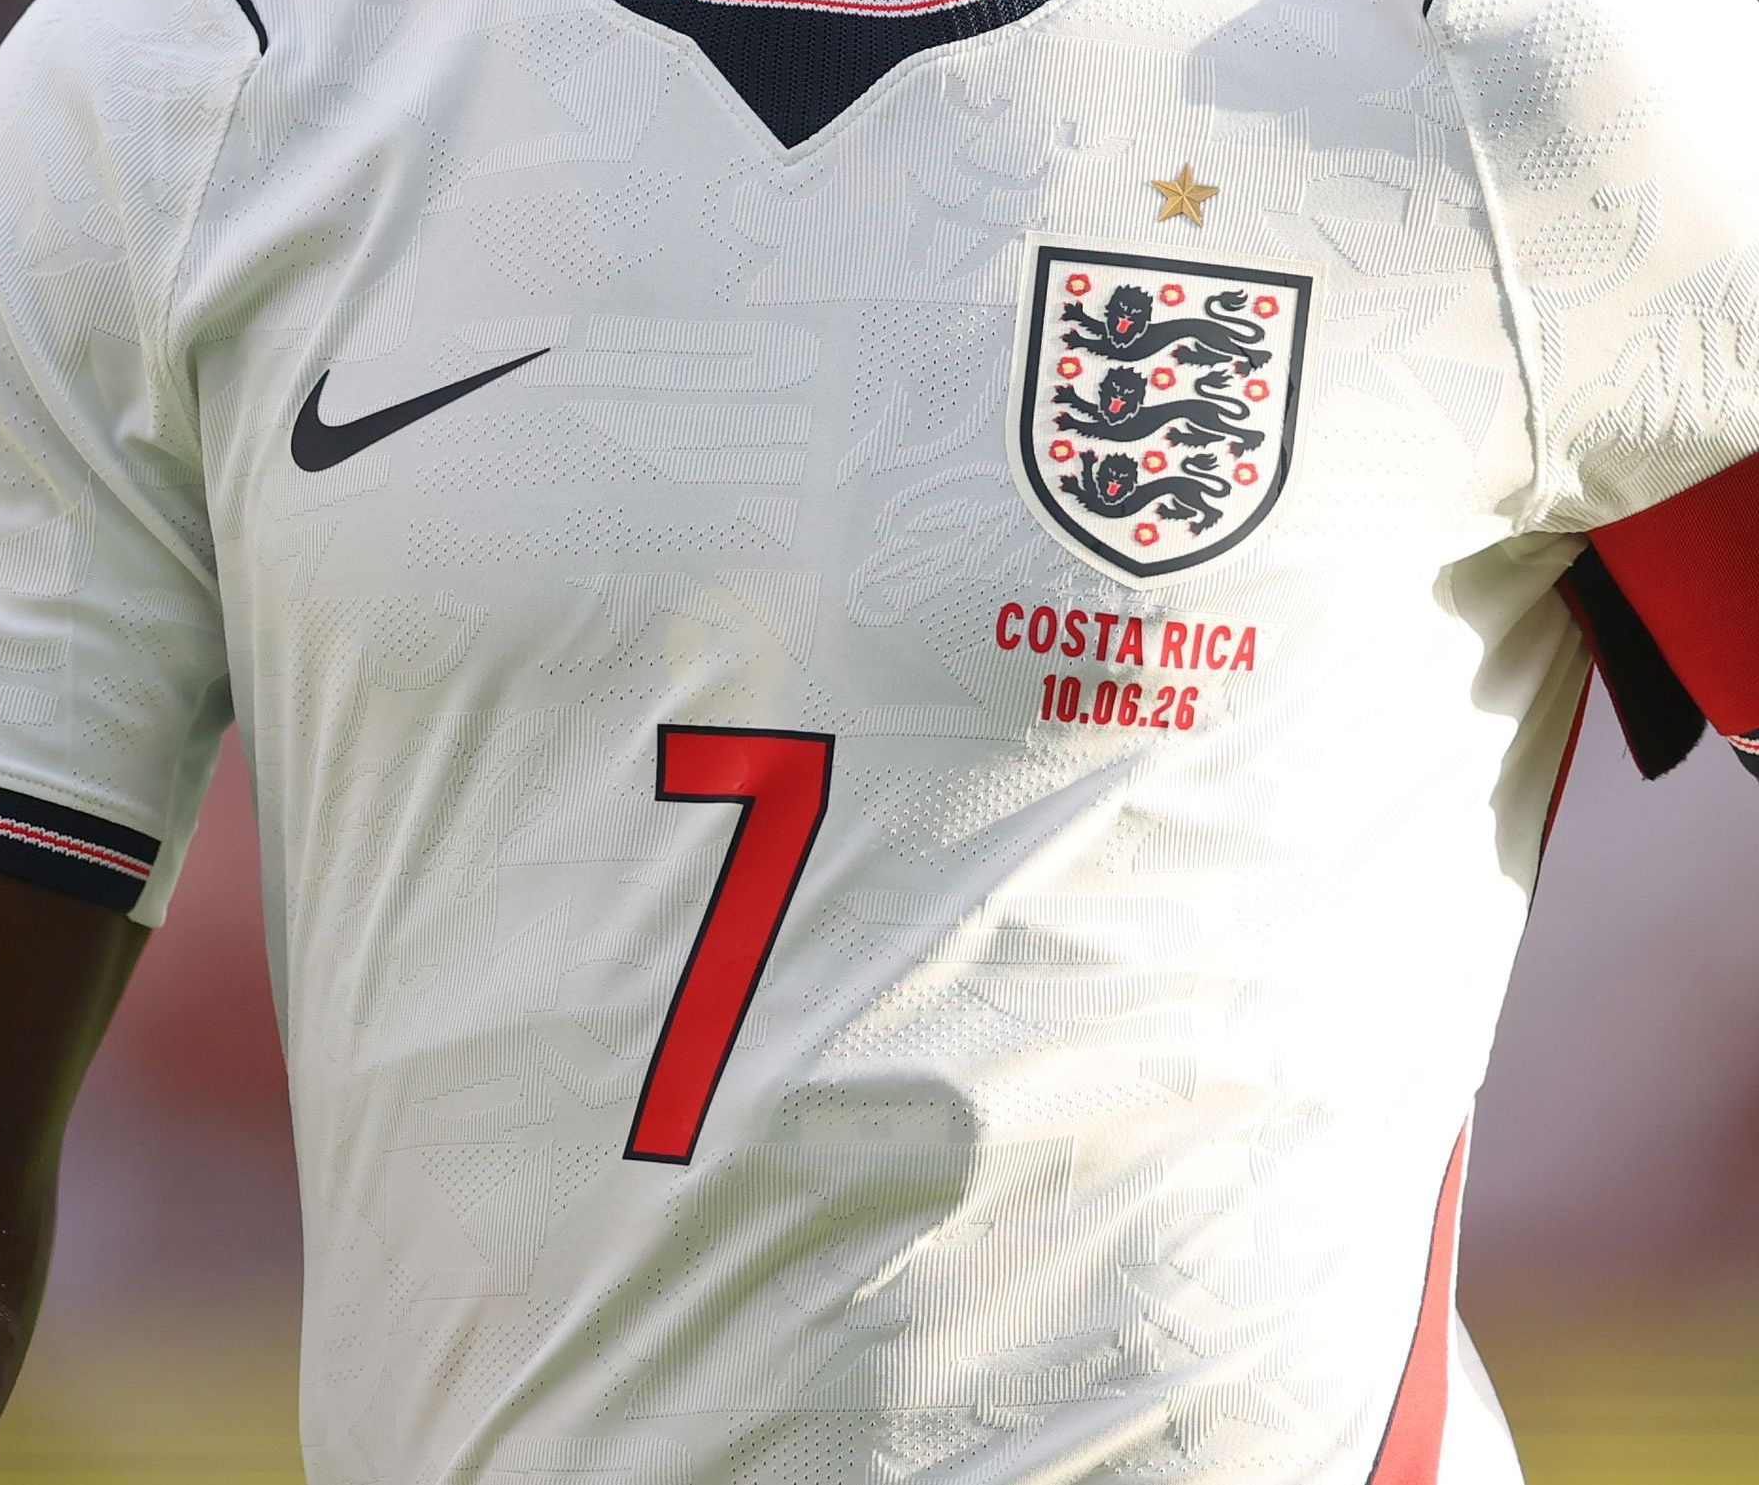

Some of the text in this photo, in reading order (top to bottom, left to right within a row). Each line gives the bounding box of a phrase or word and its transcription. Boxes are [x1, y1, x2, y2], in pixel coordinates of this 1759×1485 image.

[996, 602, 1257, 671] COSTA RICA
[1041, 674, 1198, 730] 10.06.26
[622, 724, 835, 1165] 7
